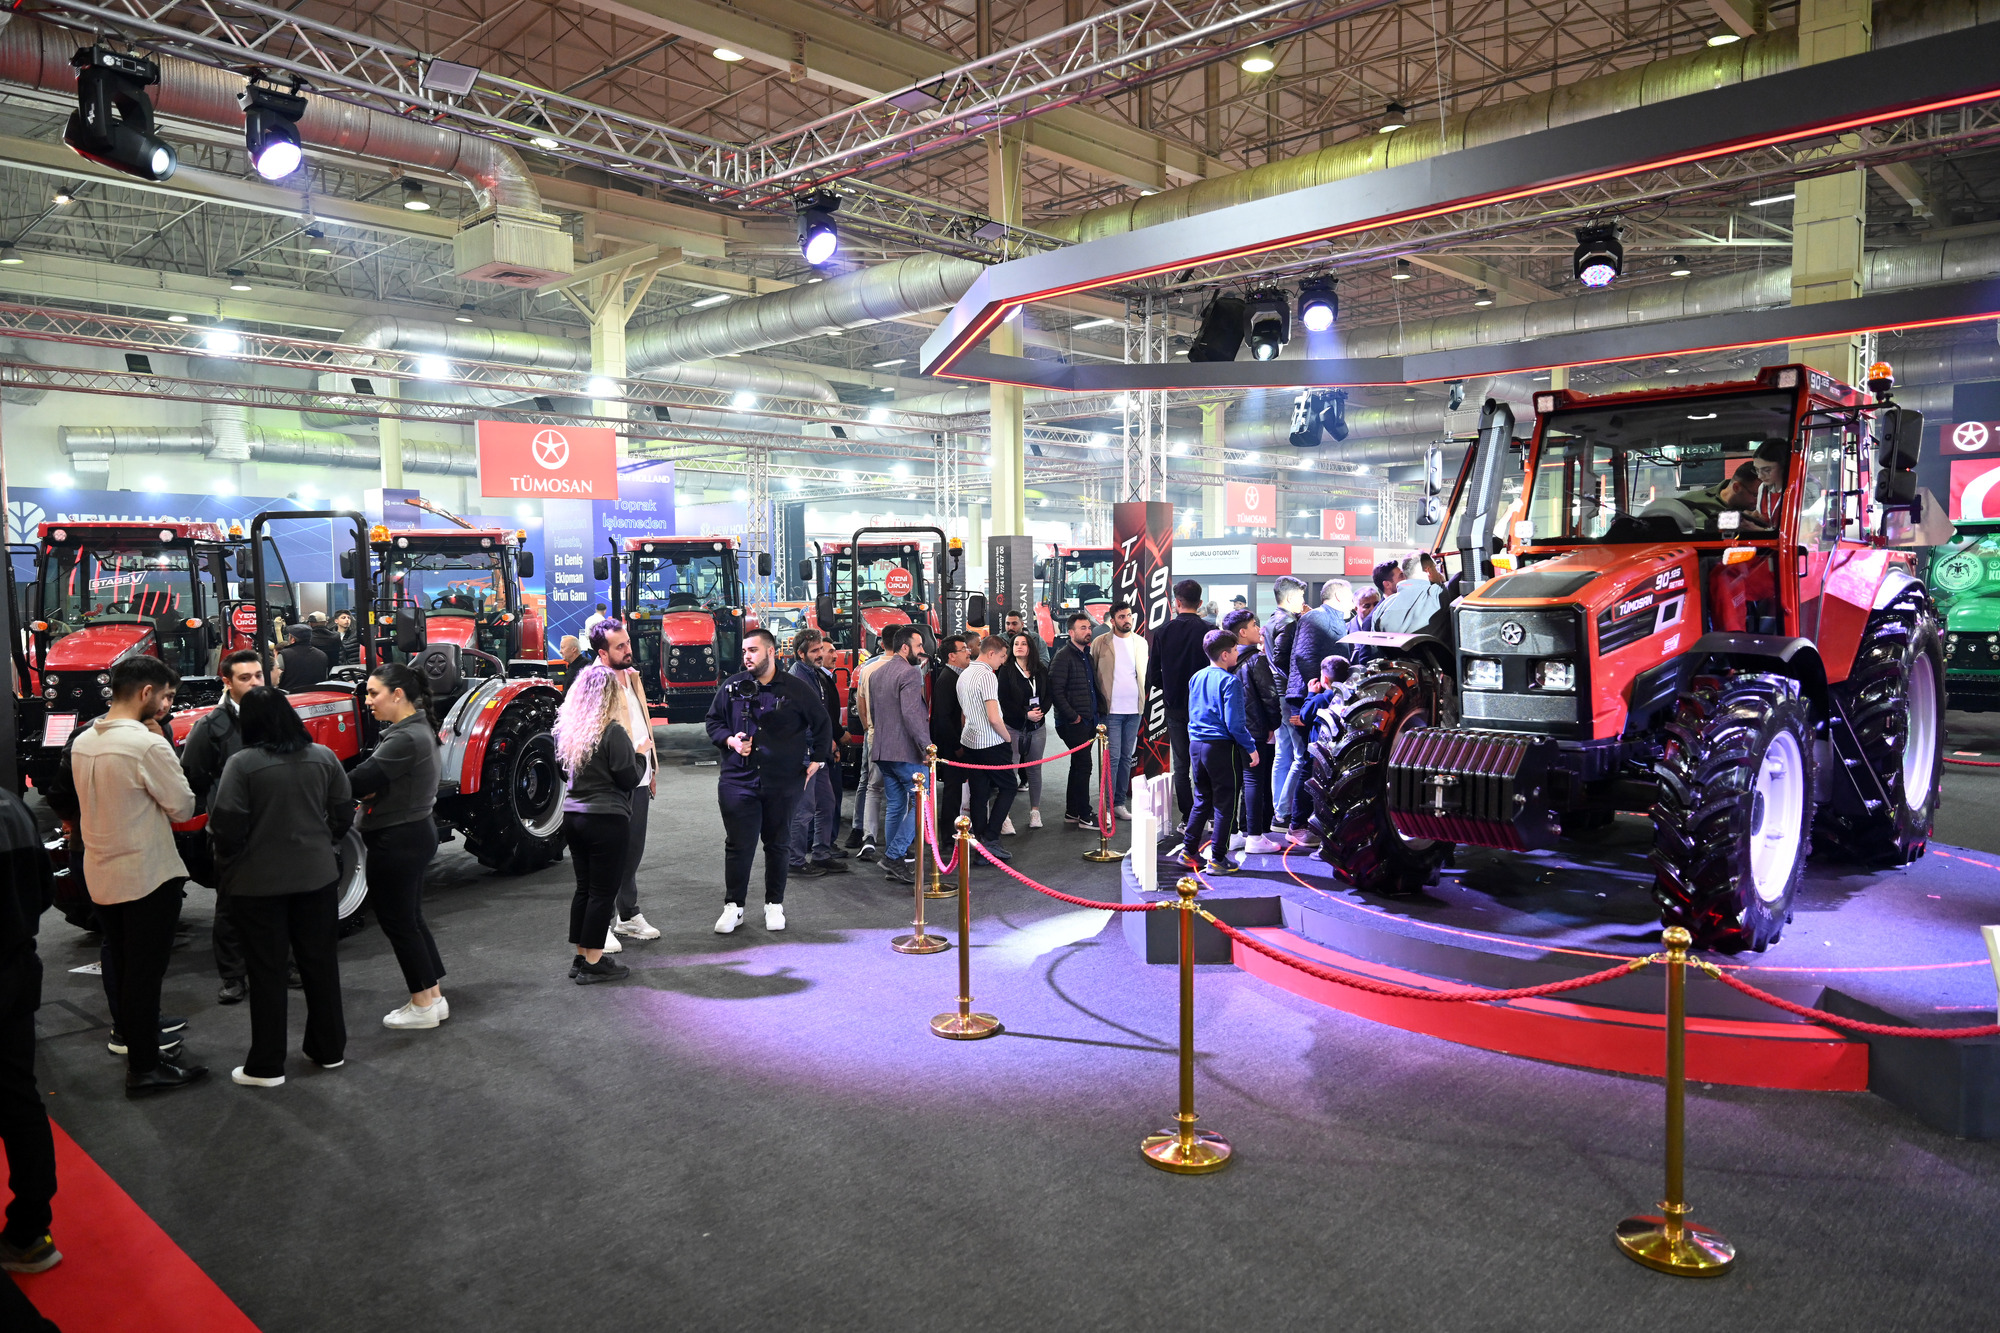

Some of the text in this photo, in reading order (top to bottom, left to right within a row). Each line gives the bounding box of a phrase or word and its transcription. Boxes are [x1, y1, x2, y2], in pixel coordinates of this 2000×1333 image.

[510, 475, 593, 494] TÜMOSAN
[602, 512, 667, 531] İşlemeden
[1237, 513, 1267, 524] TÜMOSAN
[554, 553, 584, 568] En Geniş
[1266, 555, 1289, 564] TÜMOSAN
[554, 571, 584, 586] Ekipman
[887, 581, 910, 589] ÜRÜN
[552, 587, 588, 602] Ürün Gamı
[1619, 594, 1654, 616] TÜMOSAN
